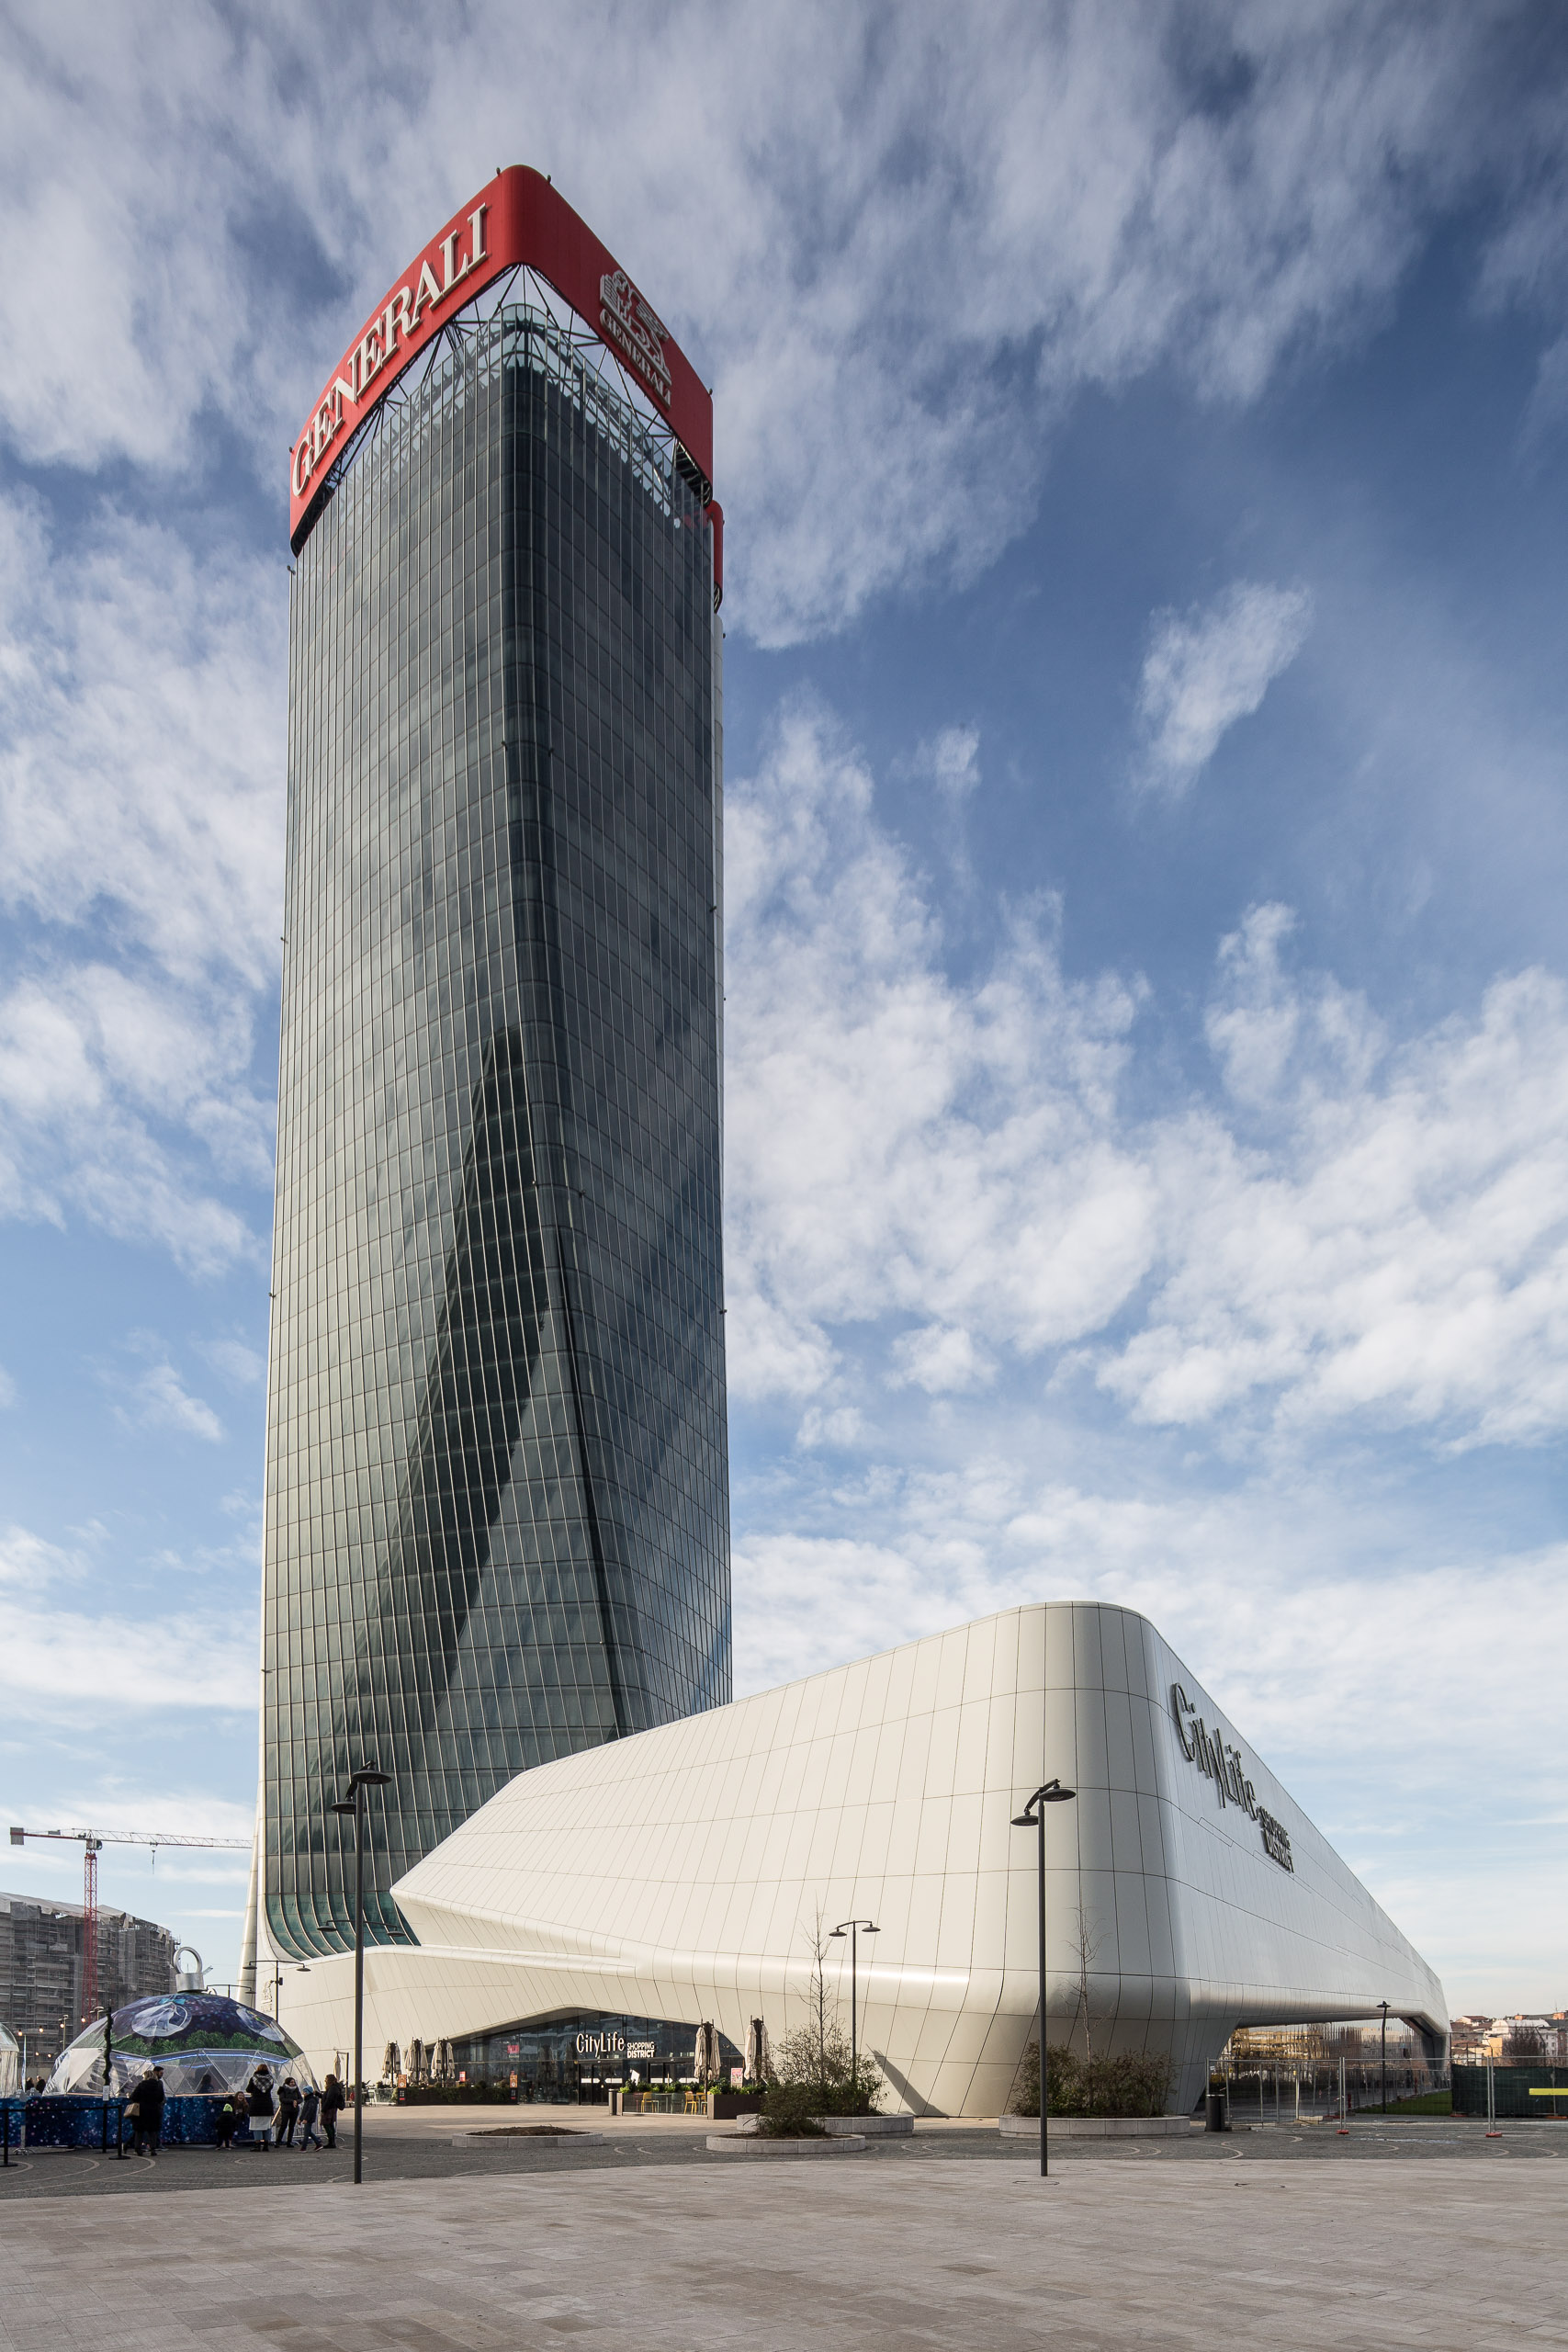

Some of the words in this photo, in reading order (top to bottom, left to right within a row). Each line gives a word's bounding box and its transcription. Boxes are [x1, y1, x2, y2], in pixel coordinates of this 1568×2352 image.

[292, 203, 489, 497] GENERALI
[600, 309, 671, 410] GENERALI
[1172, 1682, 1258, 1821] CityLife
[576, 2031, 625, 2058] CityLife
[626, 2041, 655, 2051] SHOPPING
[626, 2050, 655, 2059] DISTRICT
